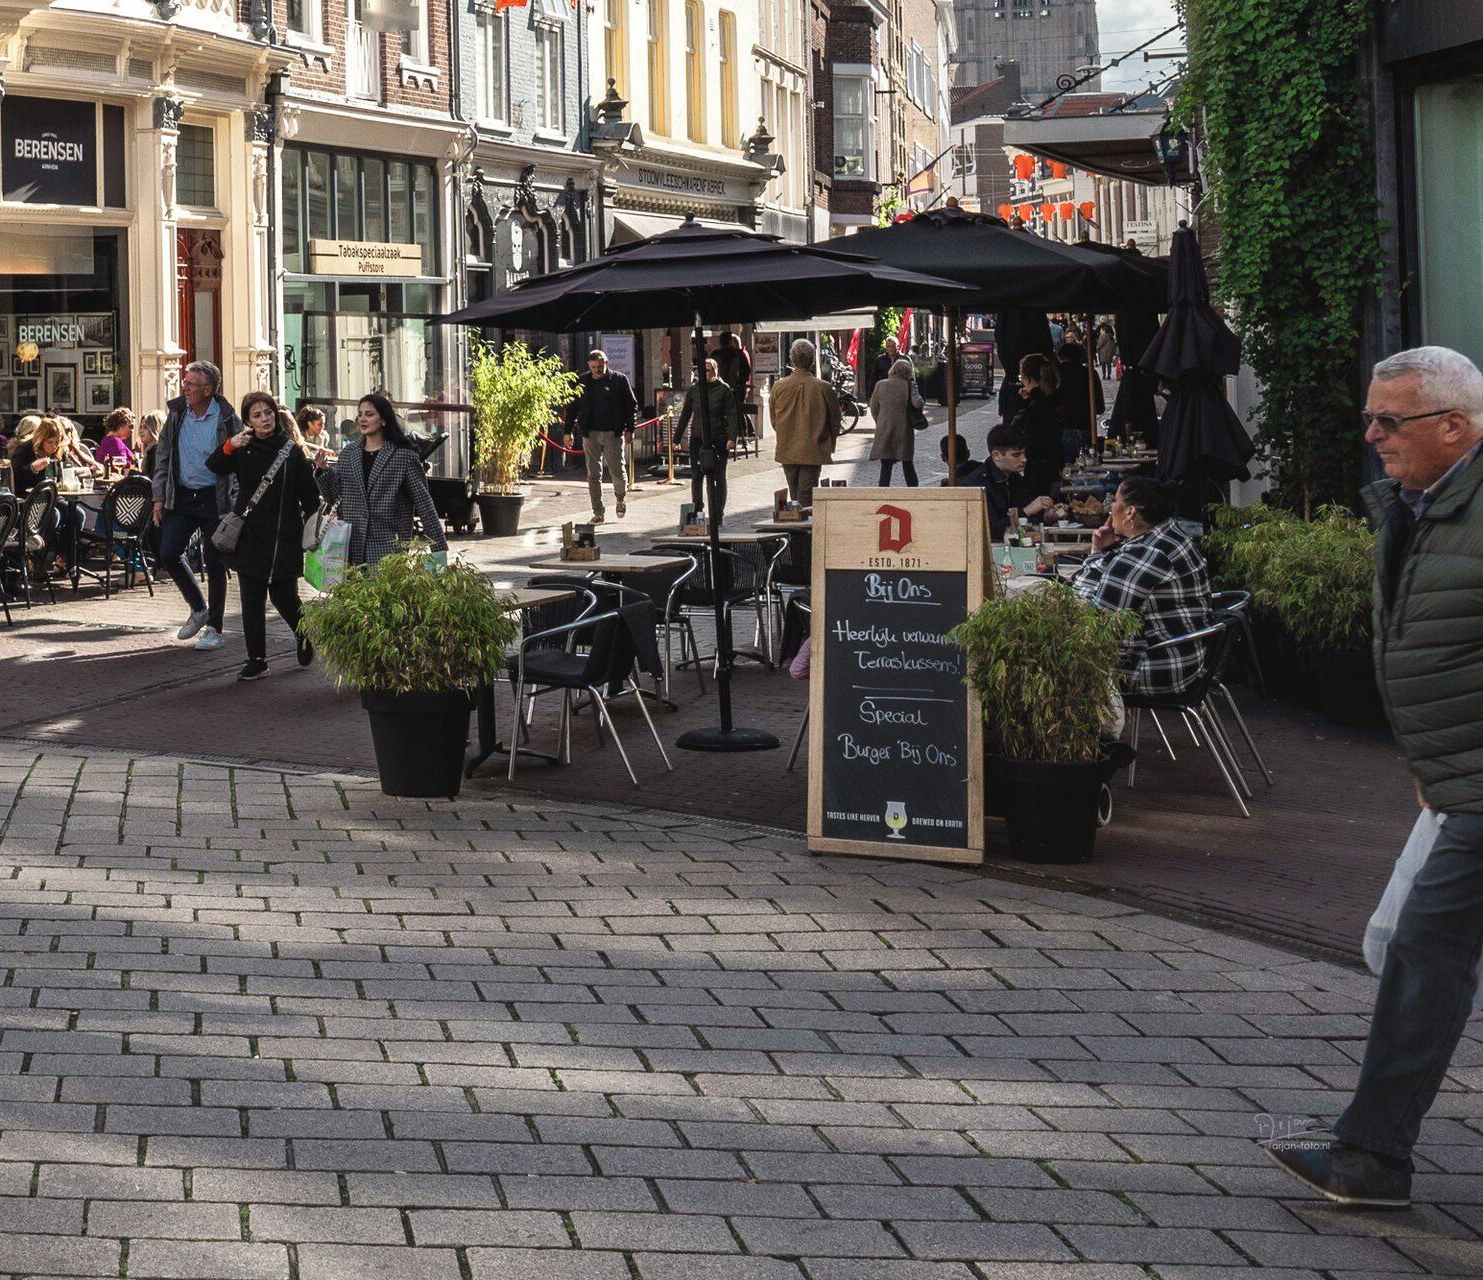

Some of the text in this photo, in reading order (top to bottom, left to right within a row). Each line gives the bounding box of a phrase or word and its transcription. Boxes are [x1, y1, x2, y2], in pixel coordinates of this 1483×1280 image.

[14, 138, 83, 162] BERENSEN
[338, 244, 402, 260] Tabakspeciaalzaak
[358, 261, 384, 273] Puffstore
[19, 323, 85, 342] BERENSEN
[875, 504, 913, 554] D
[869, 557, 921, 568] ESTD. 1871
[864, 572, 932, 603] Bij Ons
[832, 619, 960, 648] Heerlijk verwarm
[853, 650, 961, 676] Terraskussens!
[859, 700, 929, 726] Special
[837, 733, 892, 765] Burger
[826, 810, 846, 820] TASTES
[846, 812, 859, 821] LIKE
[911, 817, 964, 829] BREWED ON EARTH
